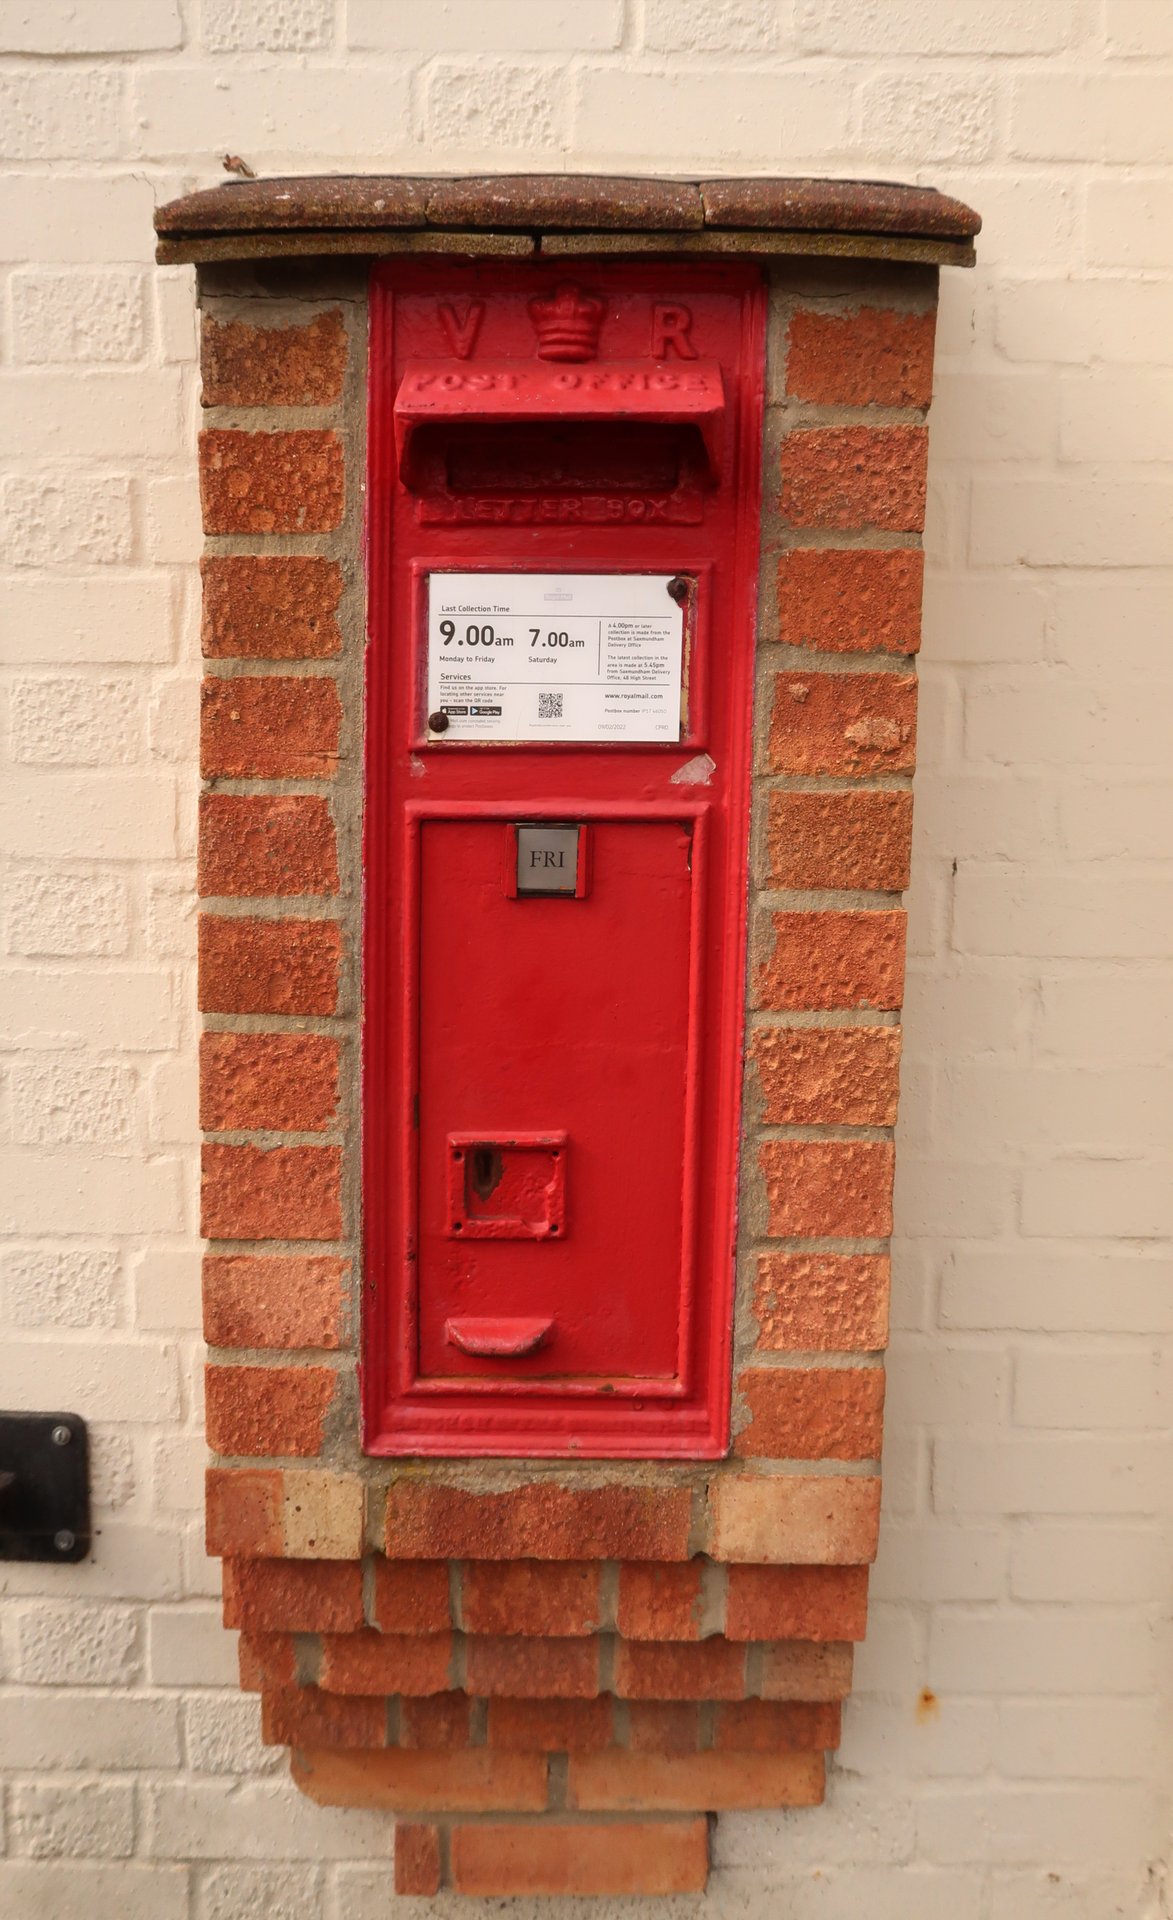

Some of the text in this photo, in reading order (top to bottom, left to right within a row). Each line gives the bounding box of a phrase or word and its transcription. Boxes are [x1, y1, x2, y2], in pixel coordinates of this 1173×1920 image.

[438, 301, 698, 360] V R
[409, 373, 711, 393] POST OFFICE
[454, 499, 668, 520] LETTER BOX
[439, 620, 514, 647] 9.00am
[528, 628, 585, 648] 7.00am
[439, 656, 464, 664] Monday
[475, 656, 495, 664] Friday
[528, 656, 557, 664] Saturday
[529, 850, 566, 868] FRI
